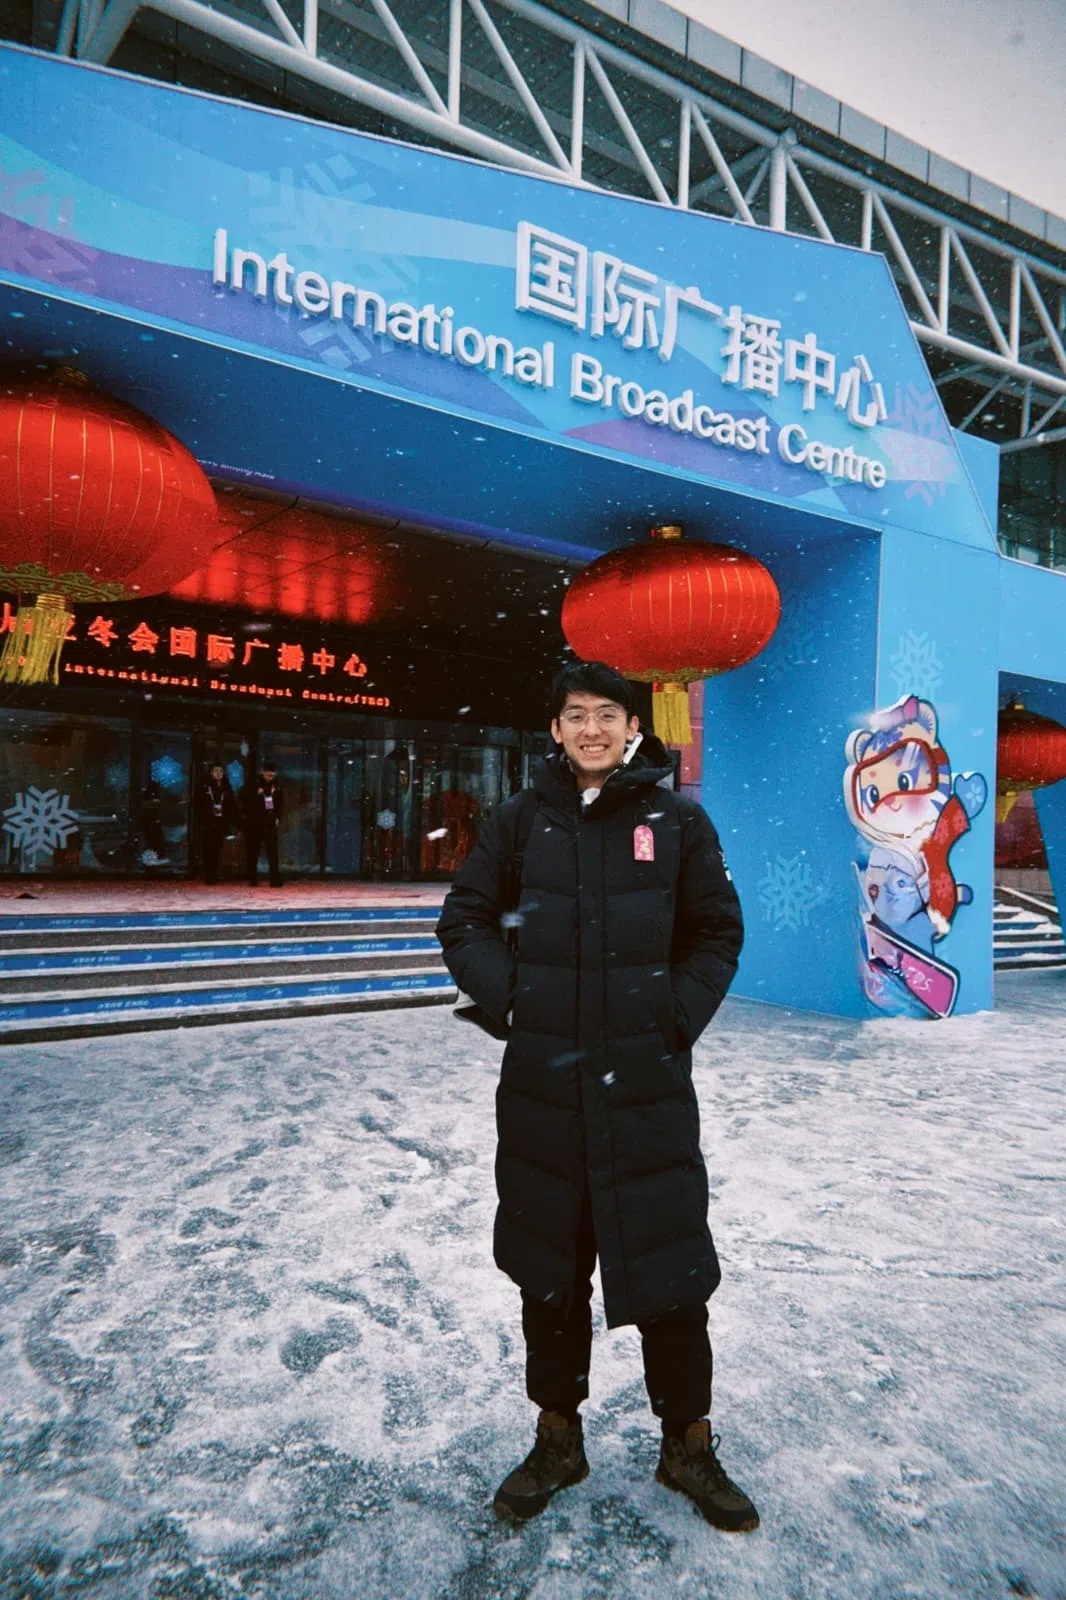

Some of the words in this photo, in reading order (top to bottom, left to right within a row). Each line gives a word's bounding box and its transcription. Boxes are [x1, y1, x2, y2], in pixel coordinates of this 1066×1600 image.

[212, 228, 554, 388] International
[569, 352, 771, 454] Broadcast
[777, 422, 887, 490] Centre
[515, 221, 888, 428] 国际广播中心
